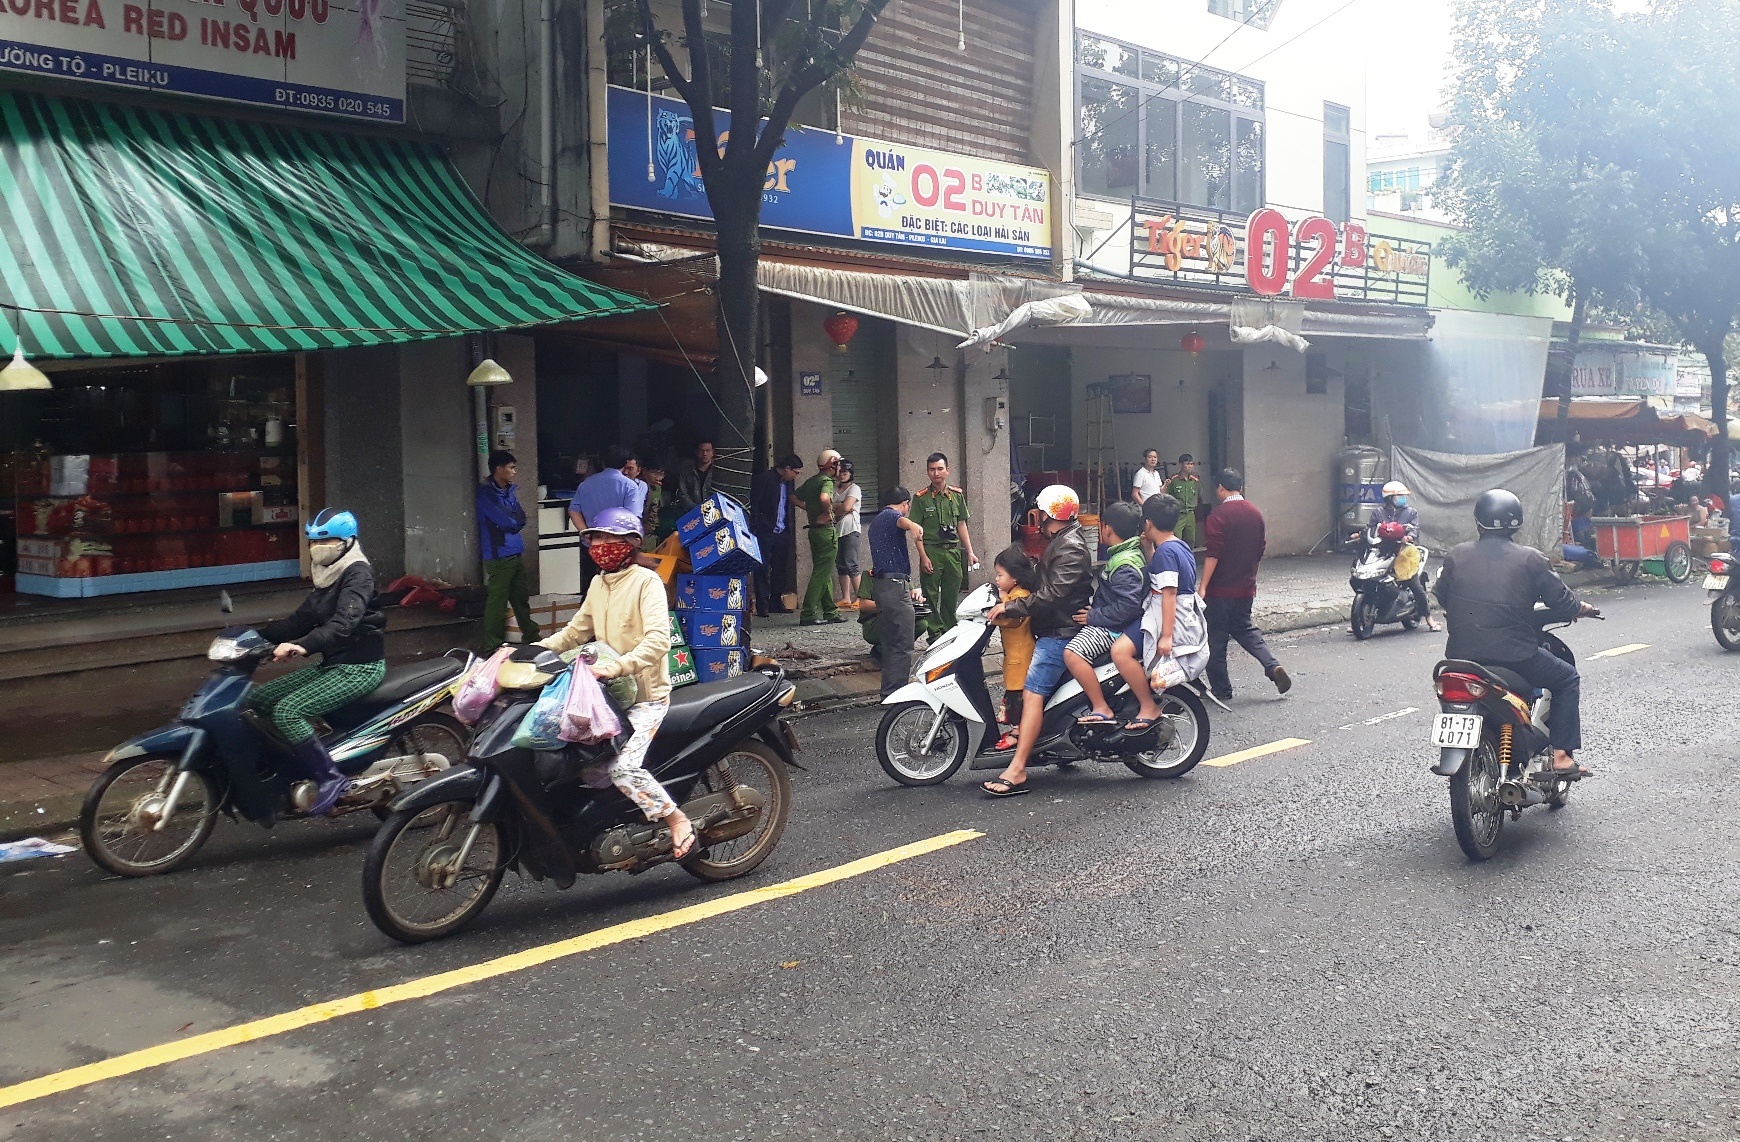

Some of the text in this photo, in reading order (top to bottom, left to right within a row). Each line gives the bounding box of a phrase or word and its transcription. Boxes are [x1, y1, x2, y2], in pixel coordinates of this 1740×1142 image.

[0, 0, 296, 60] OREA RED INSAM
[59, 55, 86, 76] TỘ
[103, 63, 168, 86] PLEIKU
[275, 88, 390, 117] ĐT:0935 020 545
[865, 148, 905, 172] QUÁN
[972, 199, 1044, 225] DUY TÂN
[902, 214, 1030, 242] ĐẶC BIỆT: CÁC LOẠI HẢI SẢN
[1143, 214, 1205, 271] Tiger
[1597, 367, 1612, 387] XE
[1441, 717, 1475, 730] 81-T3
[1438, 731, 1471, 745] 4071
